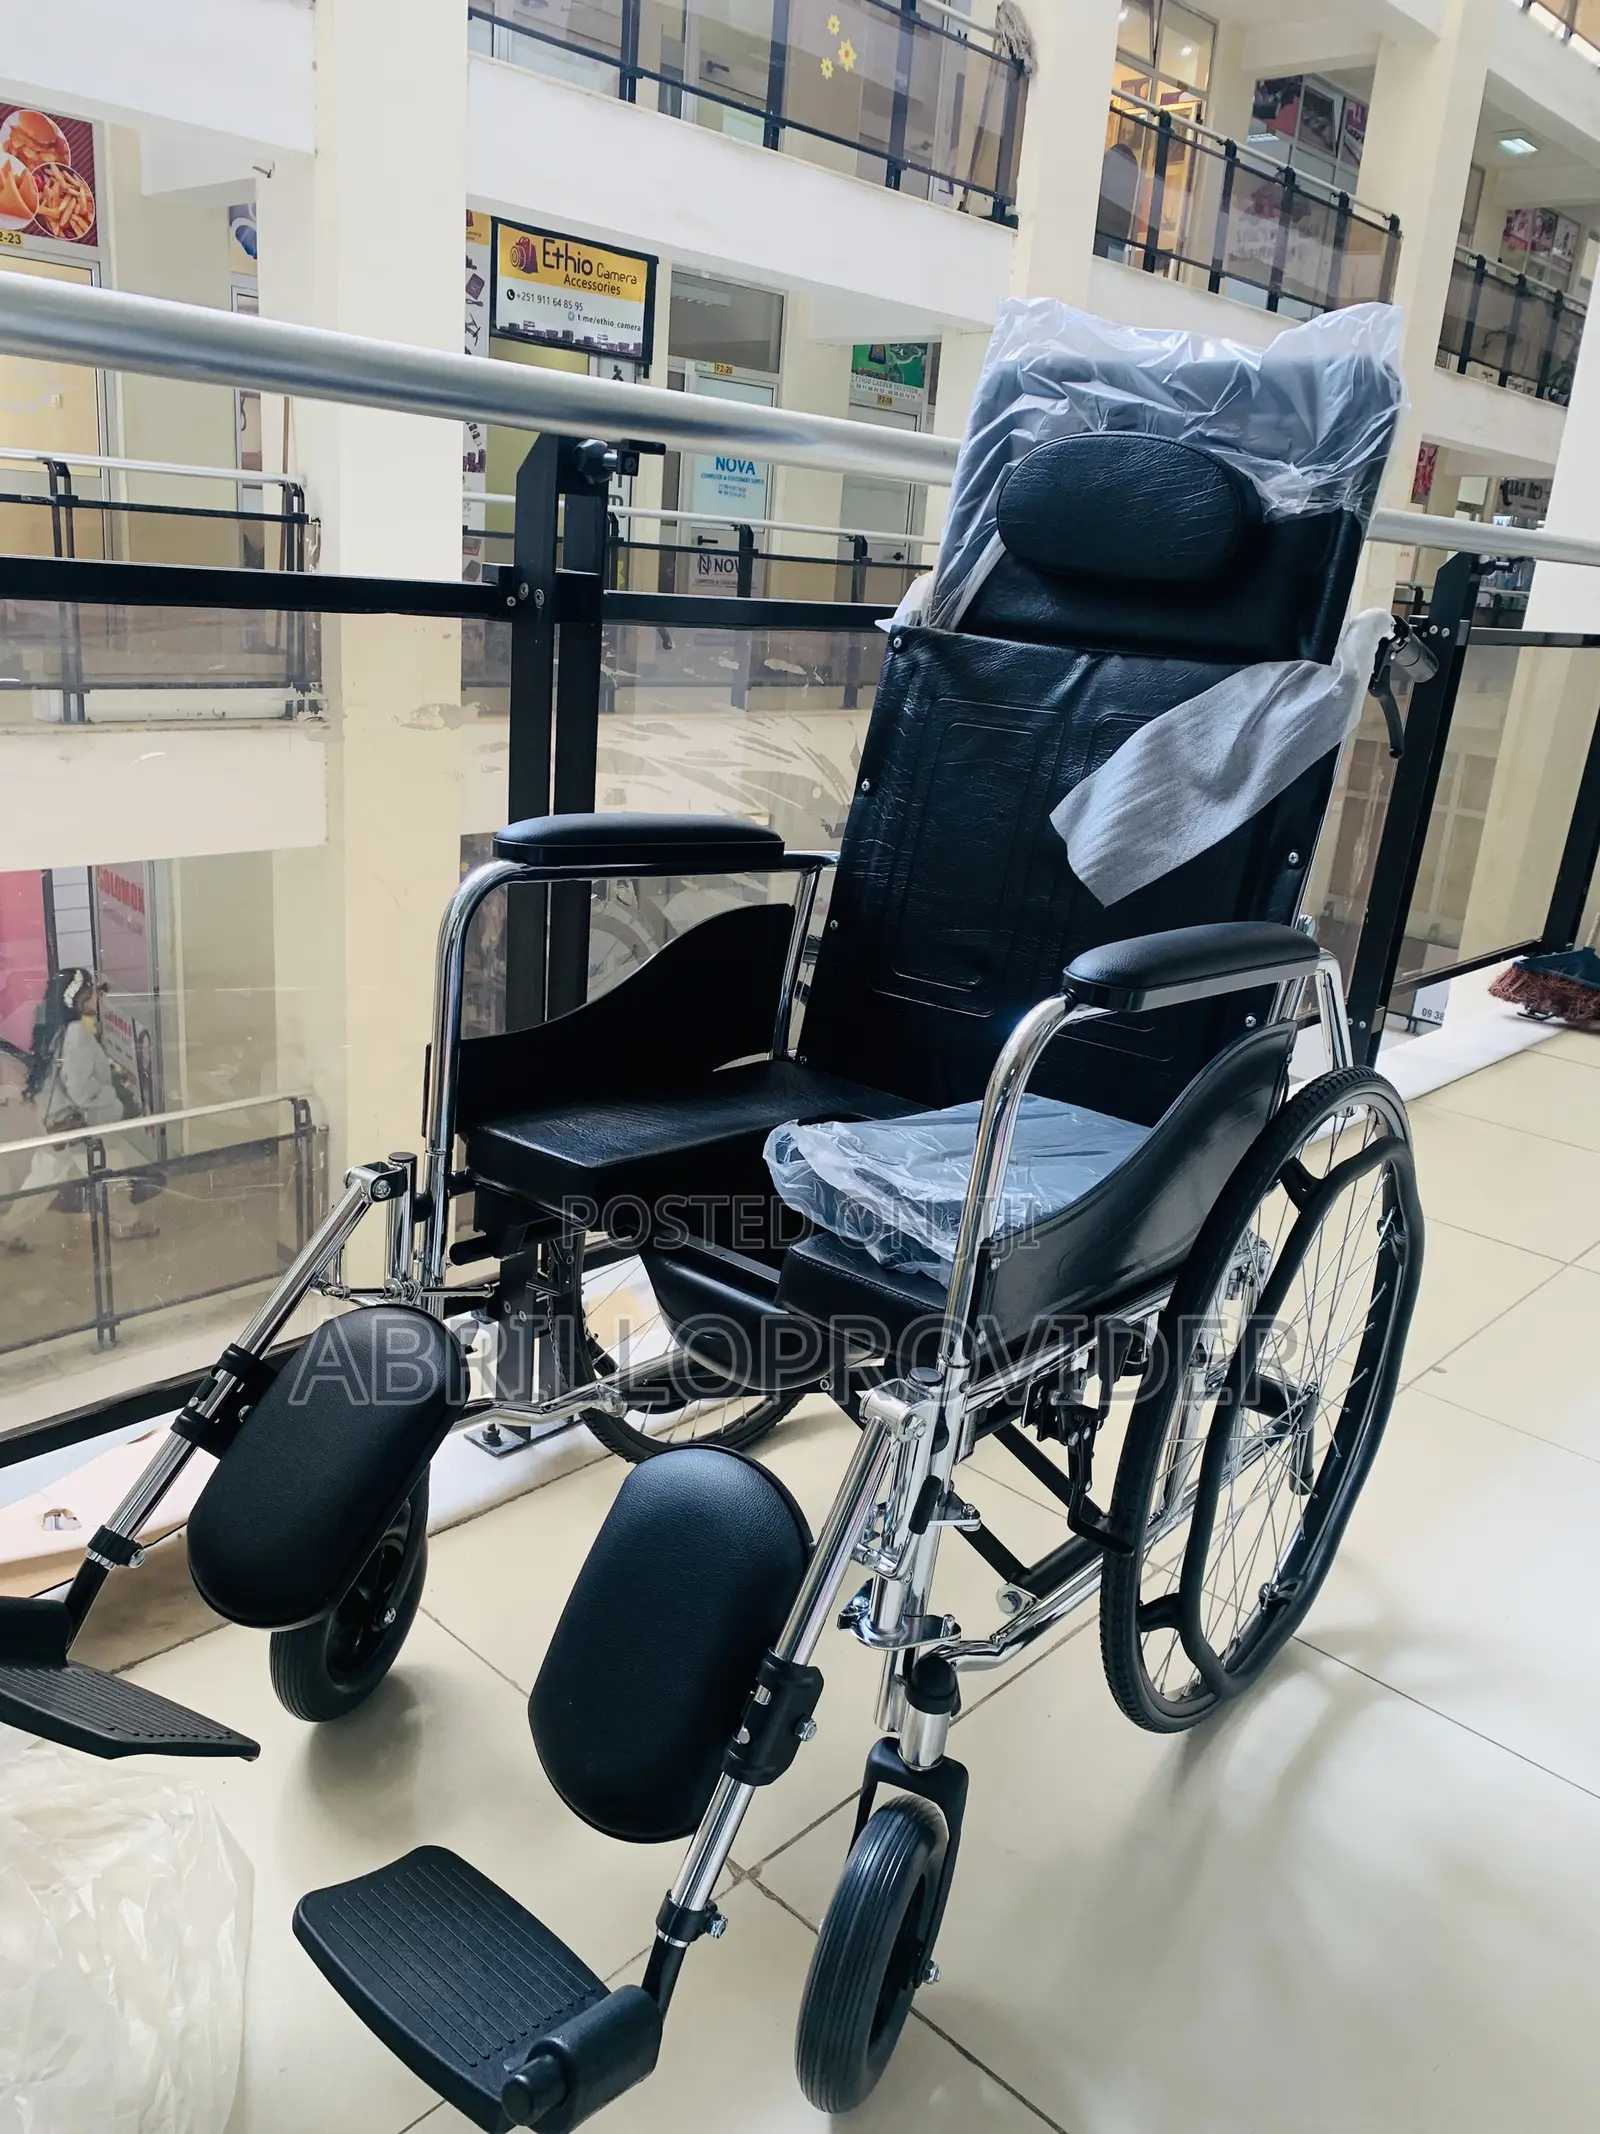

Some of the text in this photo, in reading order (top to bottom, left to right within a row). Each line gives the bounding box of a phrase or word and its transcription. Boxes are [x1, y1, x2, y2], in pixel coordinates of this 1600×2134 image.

[542, 237, 637, 285] Ethio Camera
[564, 273, 621, 296] Accessories
[516, 293, 584, 311] +251 911 64 85 95
[716, 364, 733, 374] F2-20
[715, 457, 756, 475] NOVA
[1422, 1008, 1432, 1017] 09
